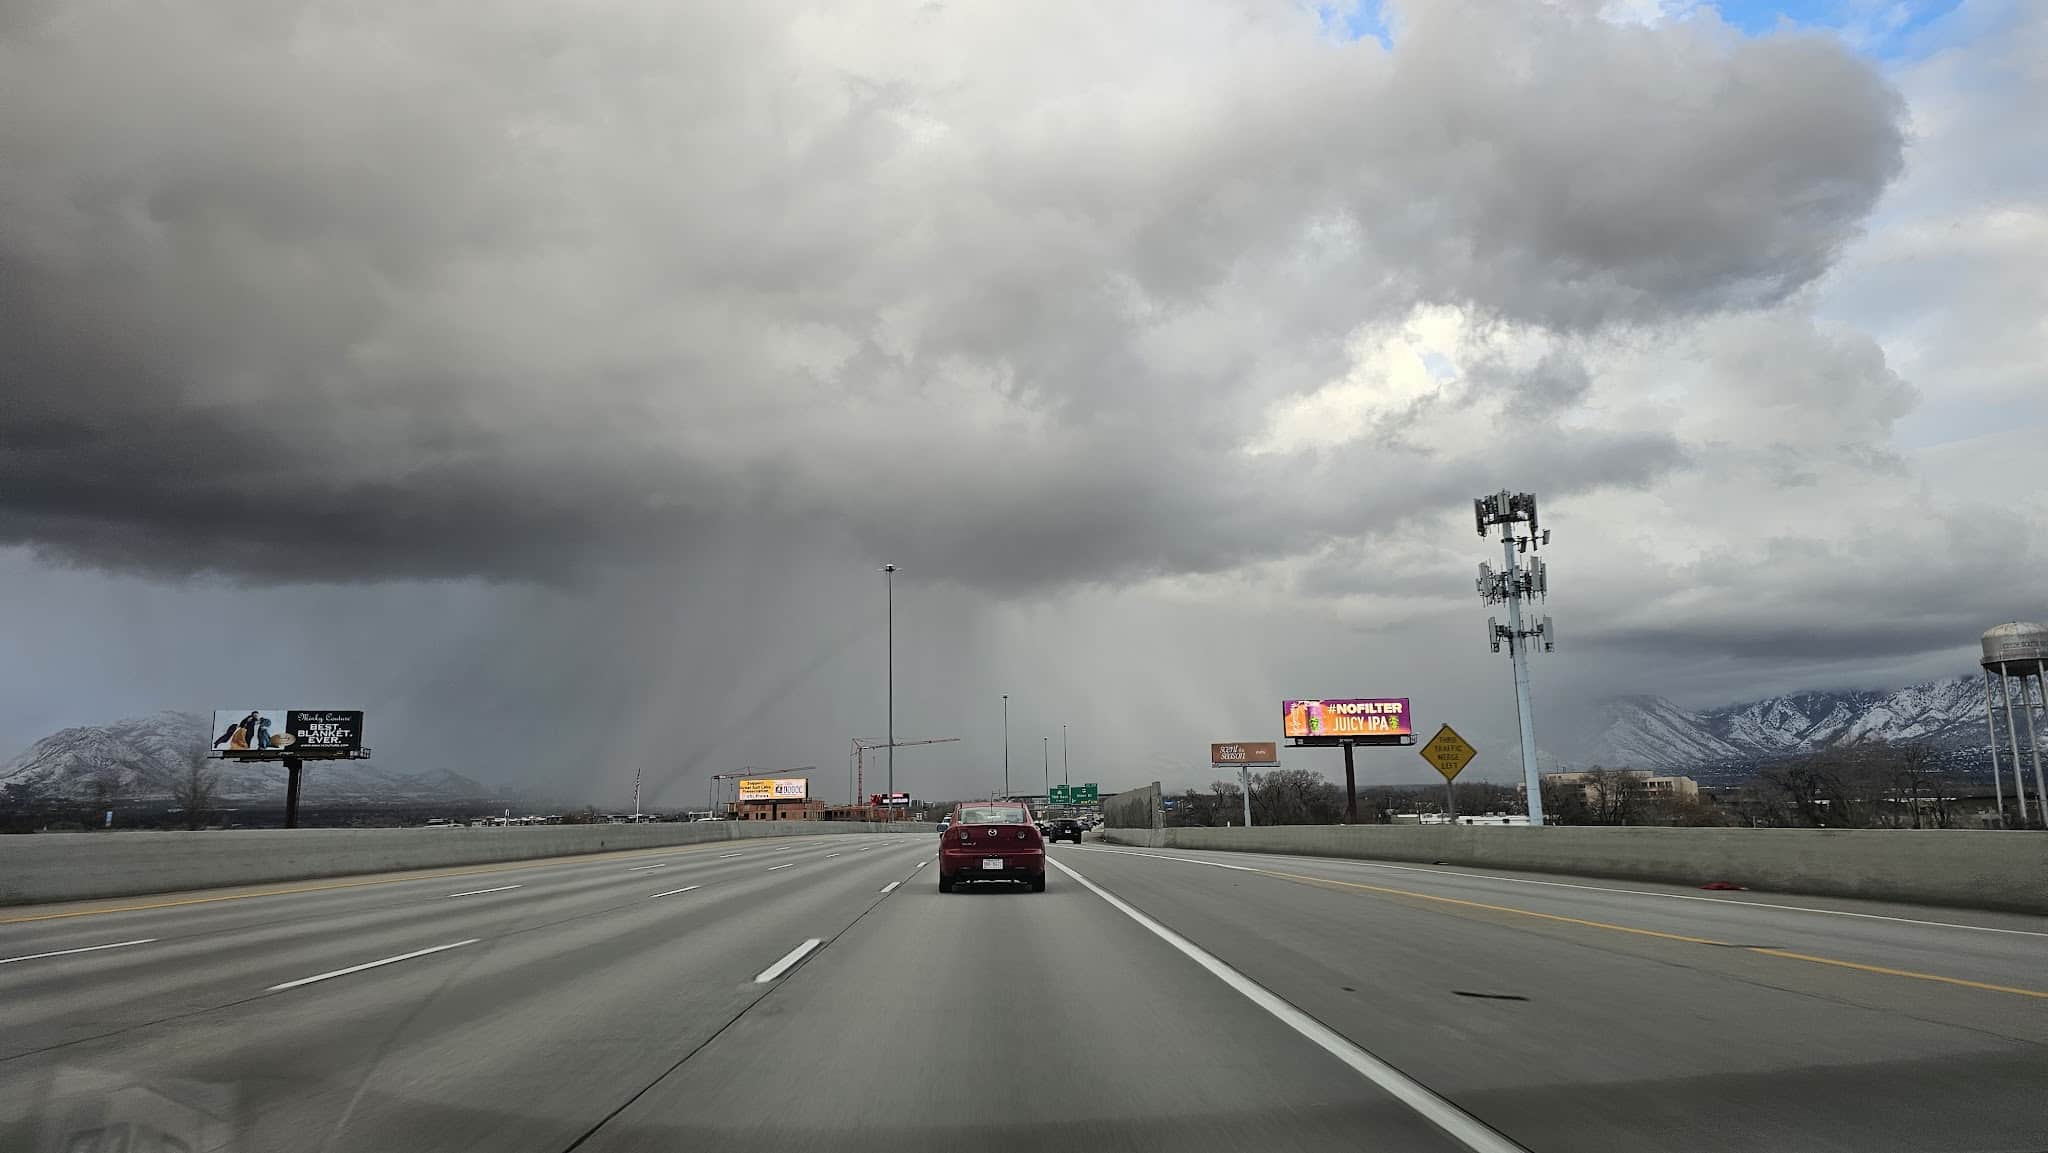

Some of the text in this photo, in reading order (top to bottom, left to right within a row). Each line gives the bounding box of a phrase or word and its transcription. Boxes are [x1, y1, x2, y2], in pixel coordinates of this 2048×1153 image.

[1328, 703, 1402, 714] #NOFILTER
[298, 713, 352, 723] Minky Couture
[1333, 716, 1389, 731] JUICY IPA
[298, 729, 353, 737] BLANKET.
